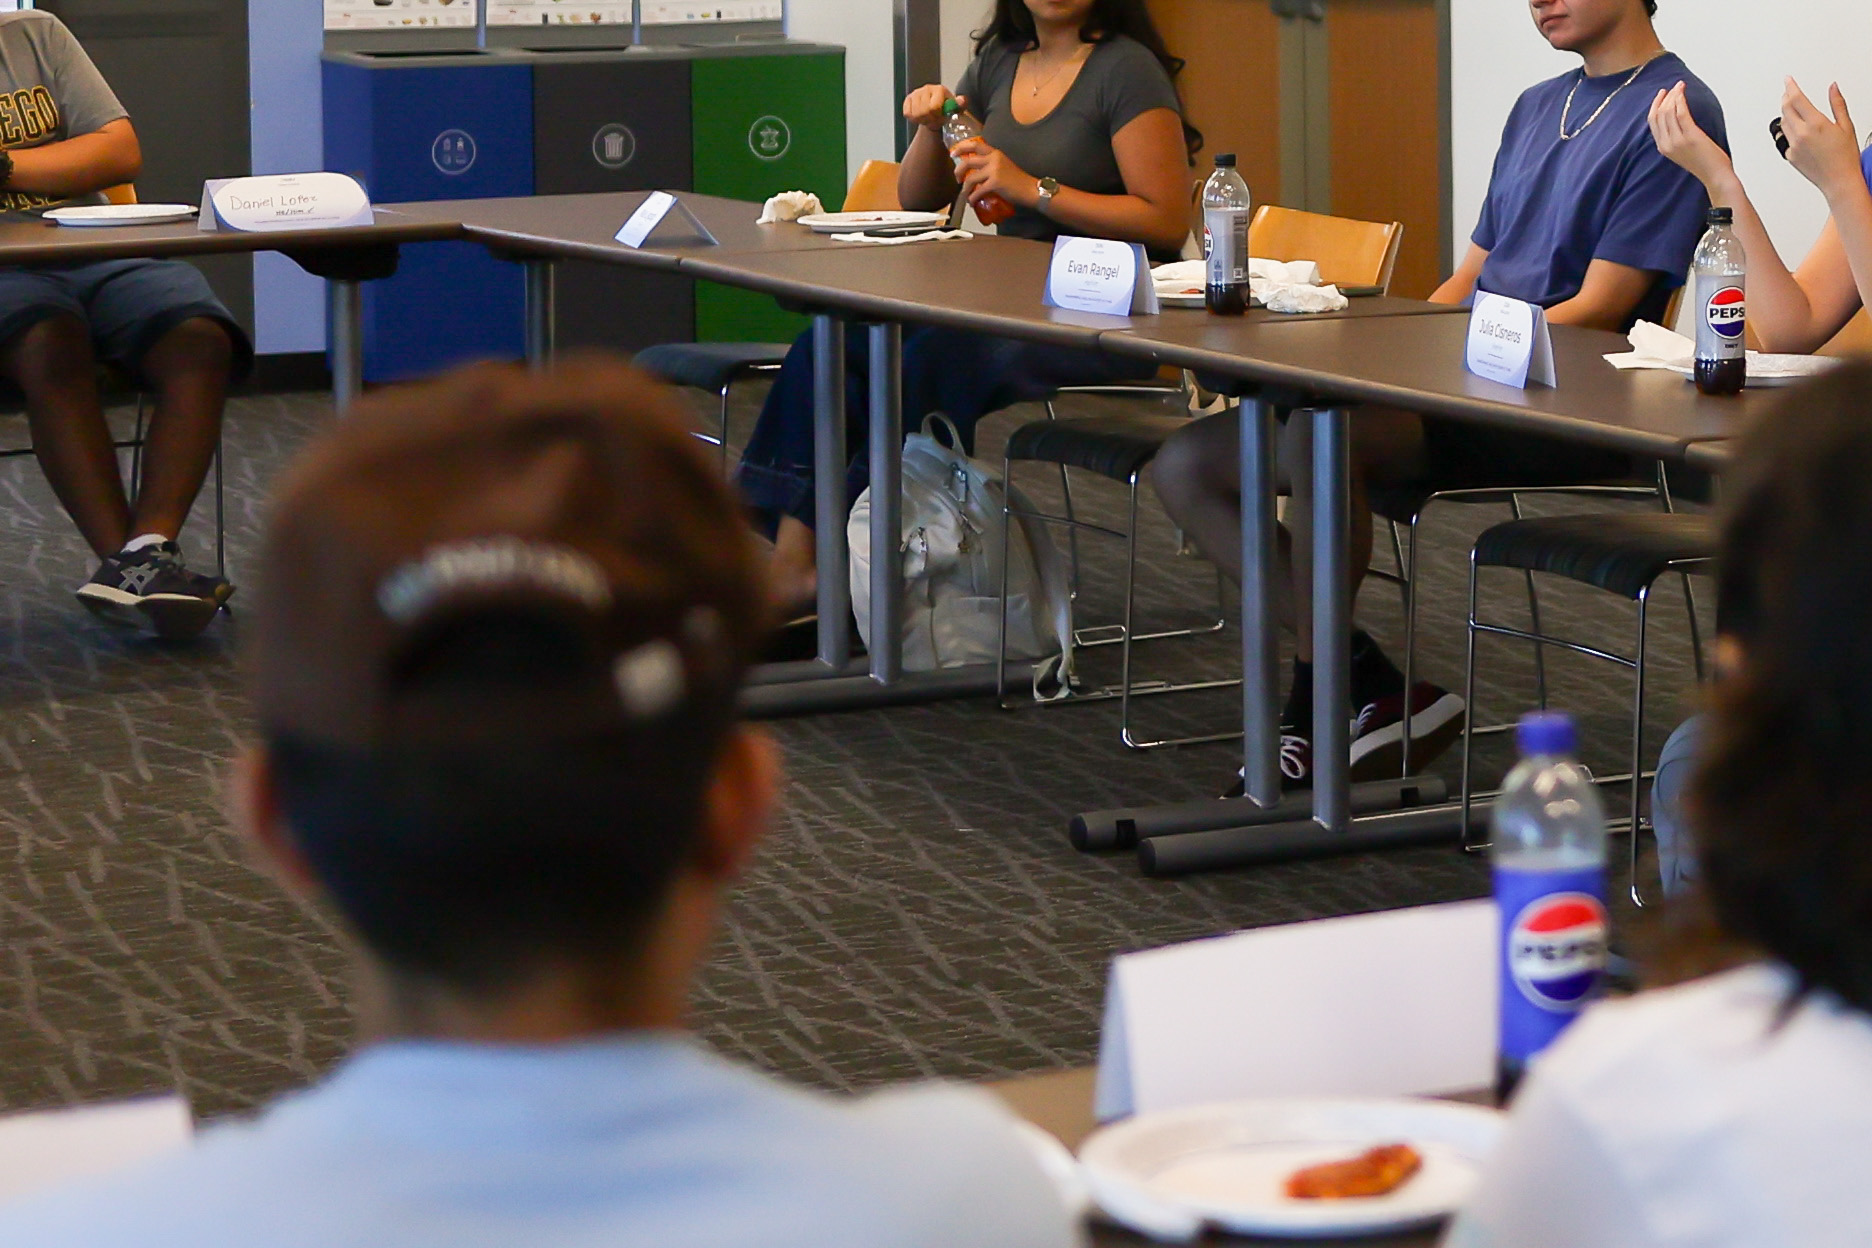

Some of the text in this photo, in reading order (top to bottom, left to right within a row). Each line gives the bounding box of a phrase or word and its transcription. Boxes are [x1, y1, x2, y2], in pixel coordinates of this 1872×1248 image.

[230, 195, 274, 211] Daniel
[1067, 259, 1120, 280] Evan Rangel
